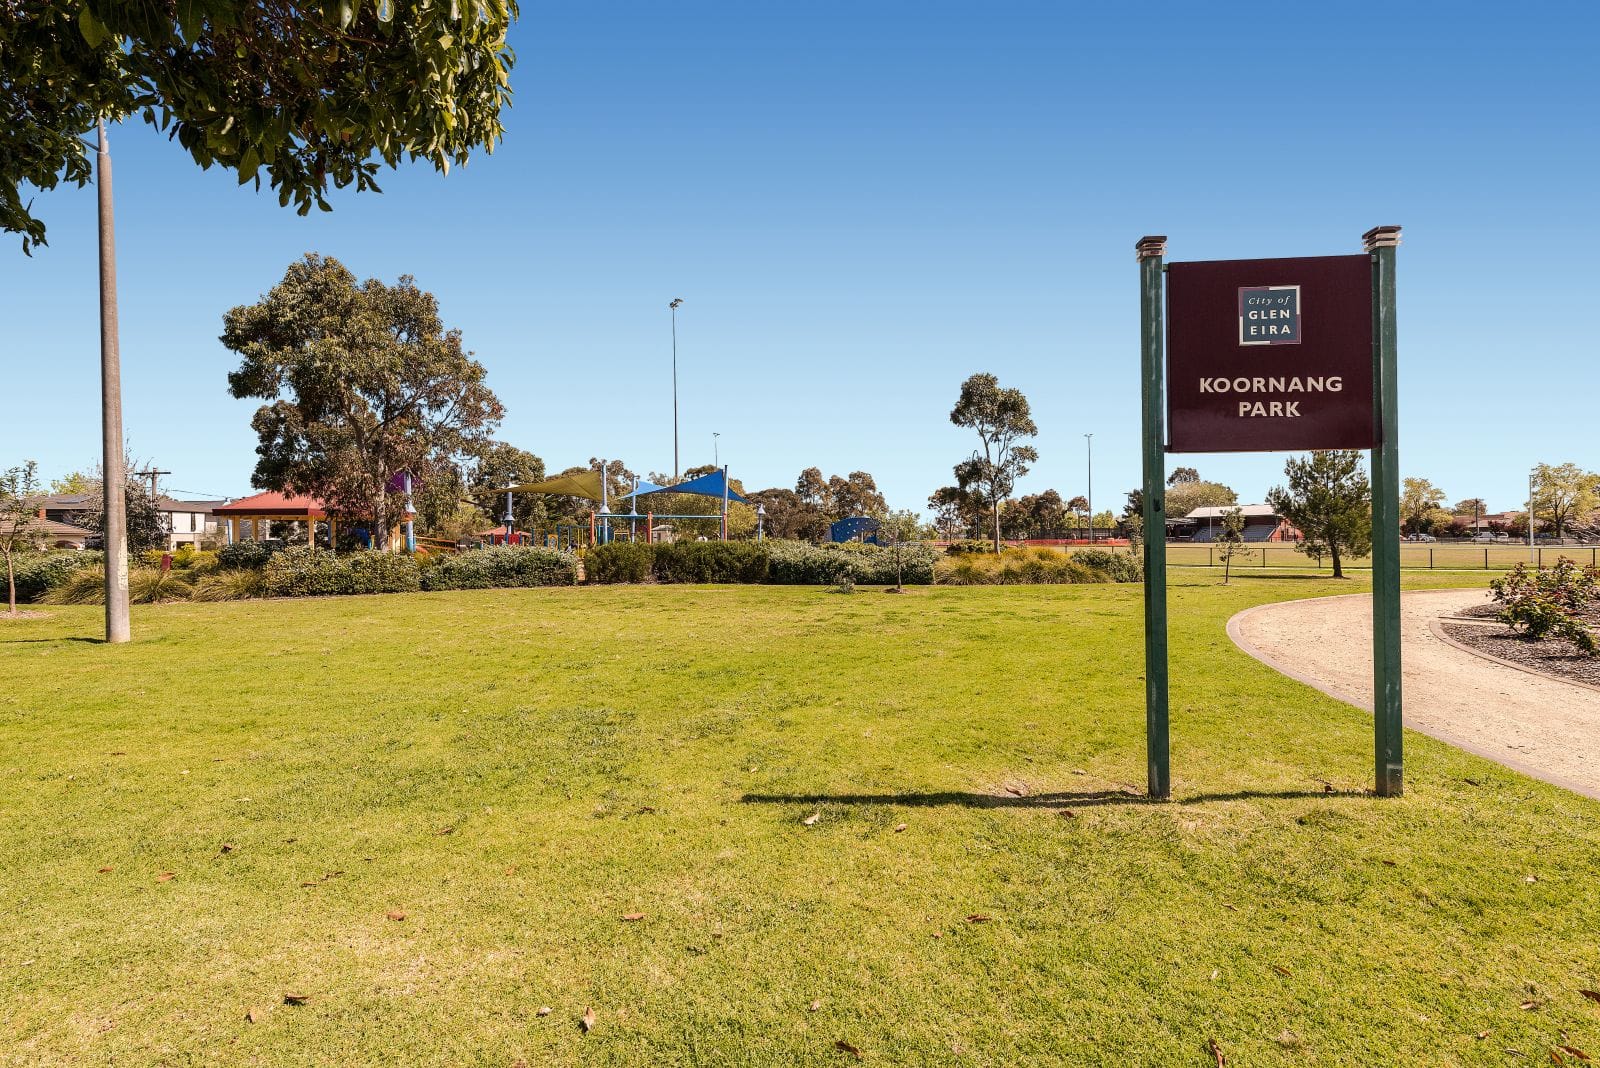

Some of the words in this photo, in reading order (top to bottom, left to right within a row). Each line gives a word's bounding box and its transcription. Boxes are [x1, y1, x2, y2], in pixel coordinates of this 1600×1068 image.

[1248, 296, 1273, 305] City
[1277, 295, 1291, 305] of
[1248, 309, 1290, 320] GLEN
[1250, 324, 1291, 335] EIRA
[1199, 376, 1343, 393] KOORNANG
[1238, 401, 1302, 418] PARK
